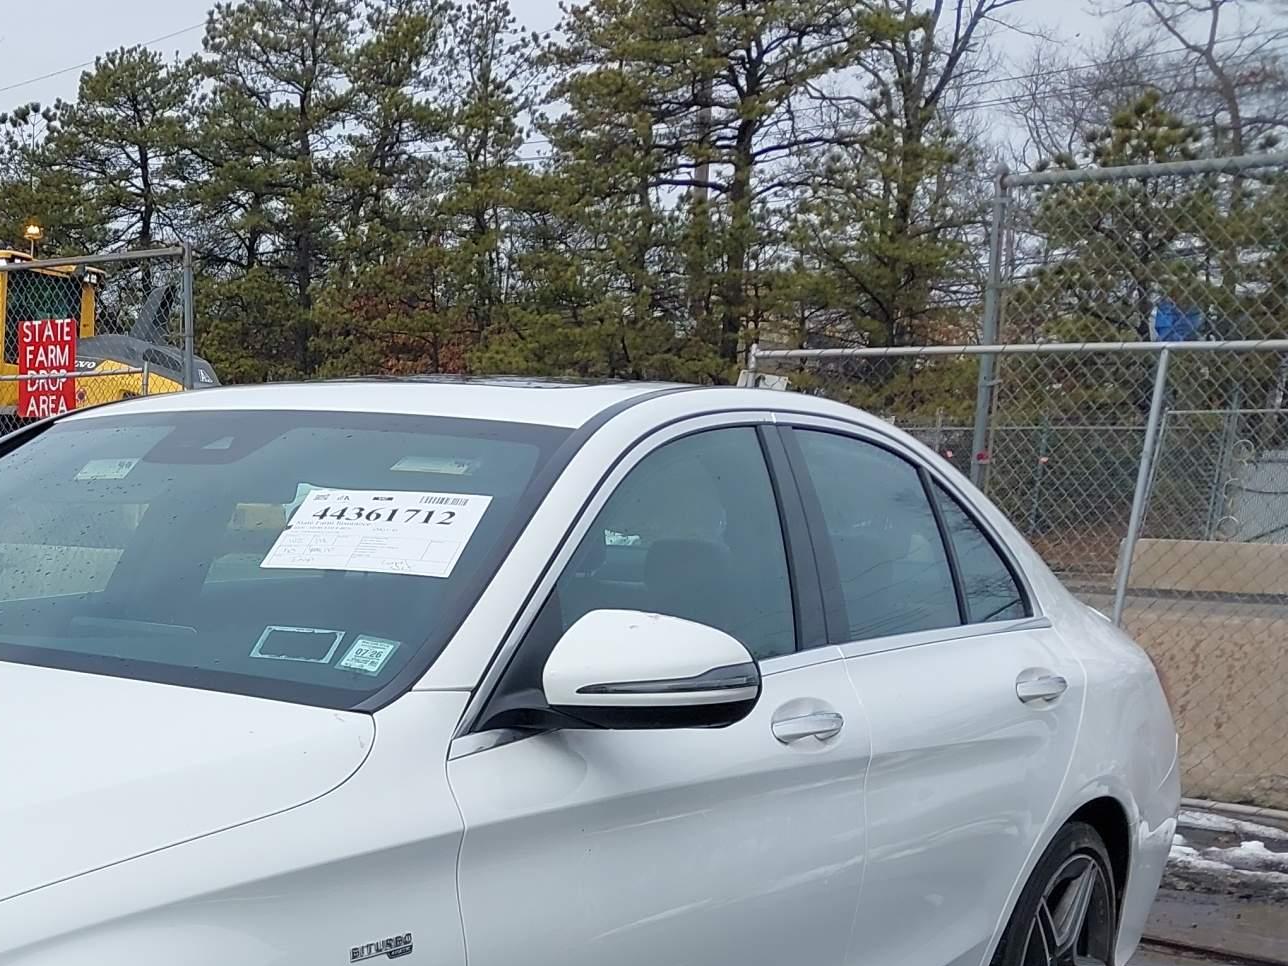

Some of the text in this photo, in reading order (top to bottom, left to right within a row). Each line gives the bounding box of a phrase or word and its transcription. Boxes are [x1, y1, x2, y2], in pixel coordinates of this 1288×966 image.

[23, 318, 71, 342] STATE
[26, 344, 69, 368] FARM
[26, 369, 68, 392] DROP
[26, 395, 67, 417] AREA
[312, 506, 456, 525] 44361712
[355, 648, 383, 658] 07 26
[351, 933, 412, 959] BITURBO
